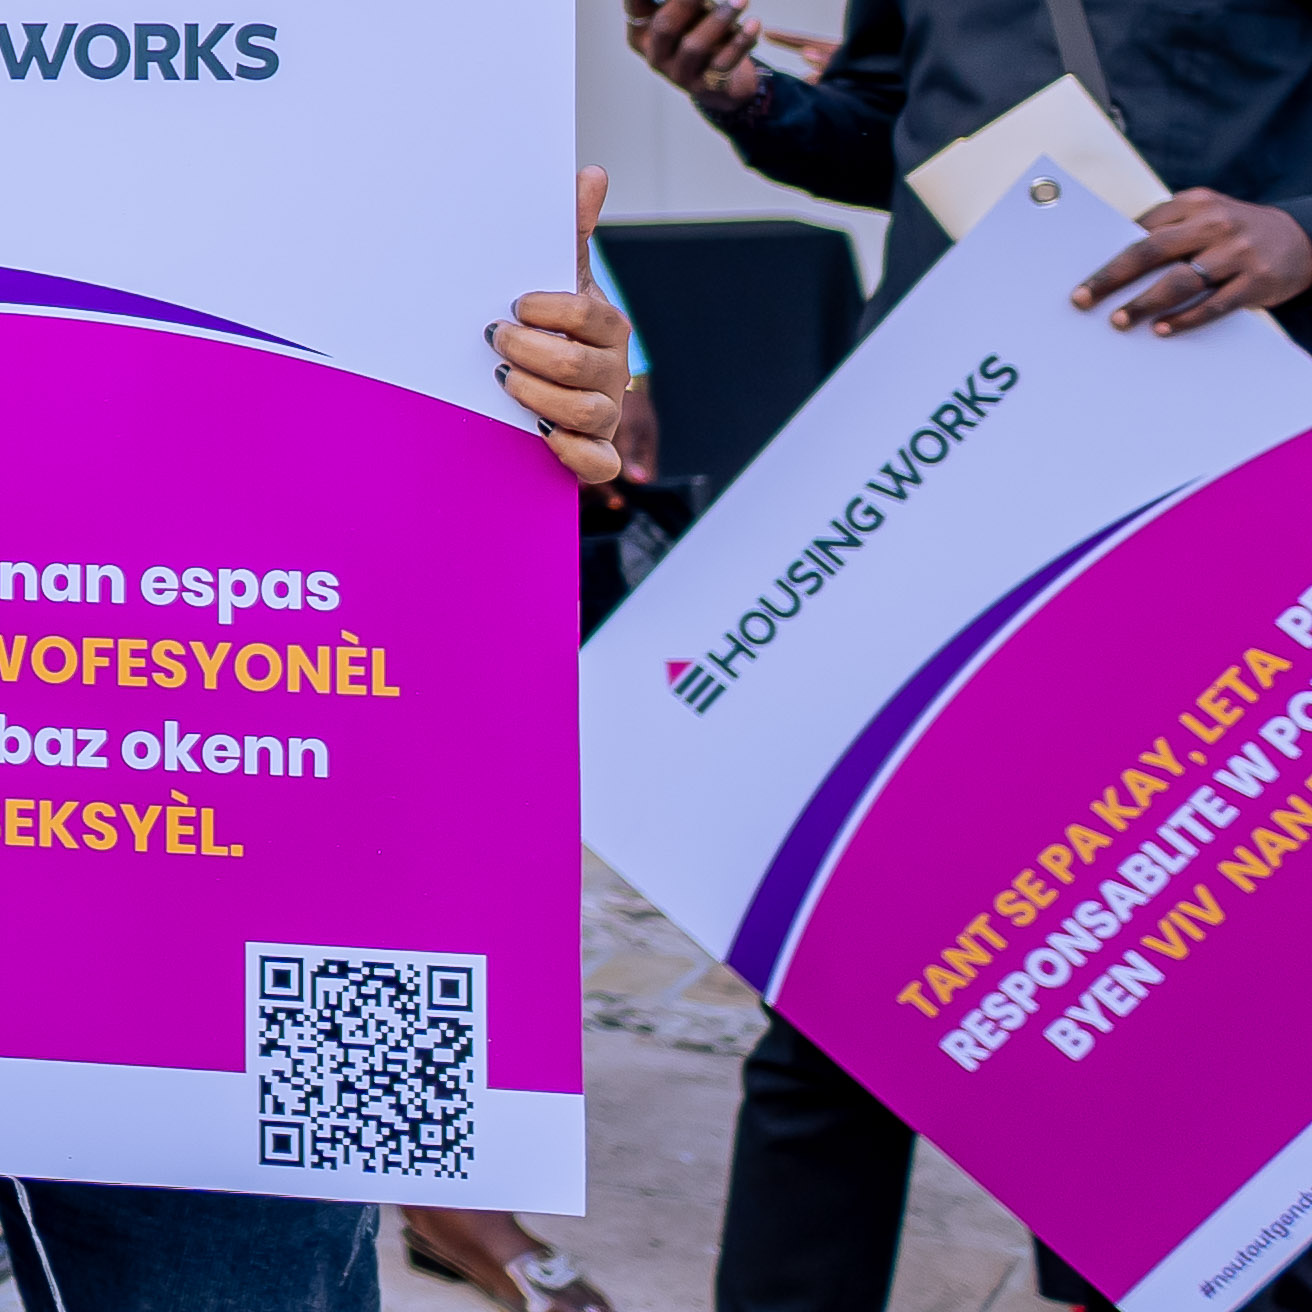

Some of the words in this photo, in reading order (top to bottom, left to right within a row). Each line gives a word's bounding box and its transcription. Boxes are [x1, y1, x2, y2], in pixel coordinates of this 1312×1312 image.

[0, 562, 125, 603] nan
[141, 566, 339, 624] espas
[712, 495, 886, 684] HOUSING
[866, 353, 1020, 501] WORKS
[122, 721, 328, 777] okenn
[898, 914, 1006, 1018] TANT
[996, 872, 1056, 925] SE
[1039, 825, 1110, 882] PA
[1092, 738, 1208, 830] KAY,
[1178, 647, 1293, 745] LETA
[940, 785, 1240, 1072] RESPONSABLITE
[1212, 741, 1280, 799] W
[1044, 951, 1164, 1060] BYEN
[1142, 886, 1223, 958] VIV
[1197, 1188, 1312, 1298] #noutoutgend
